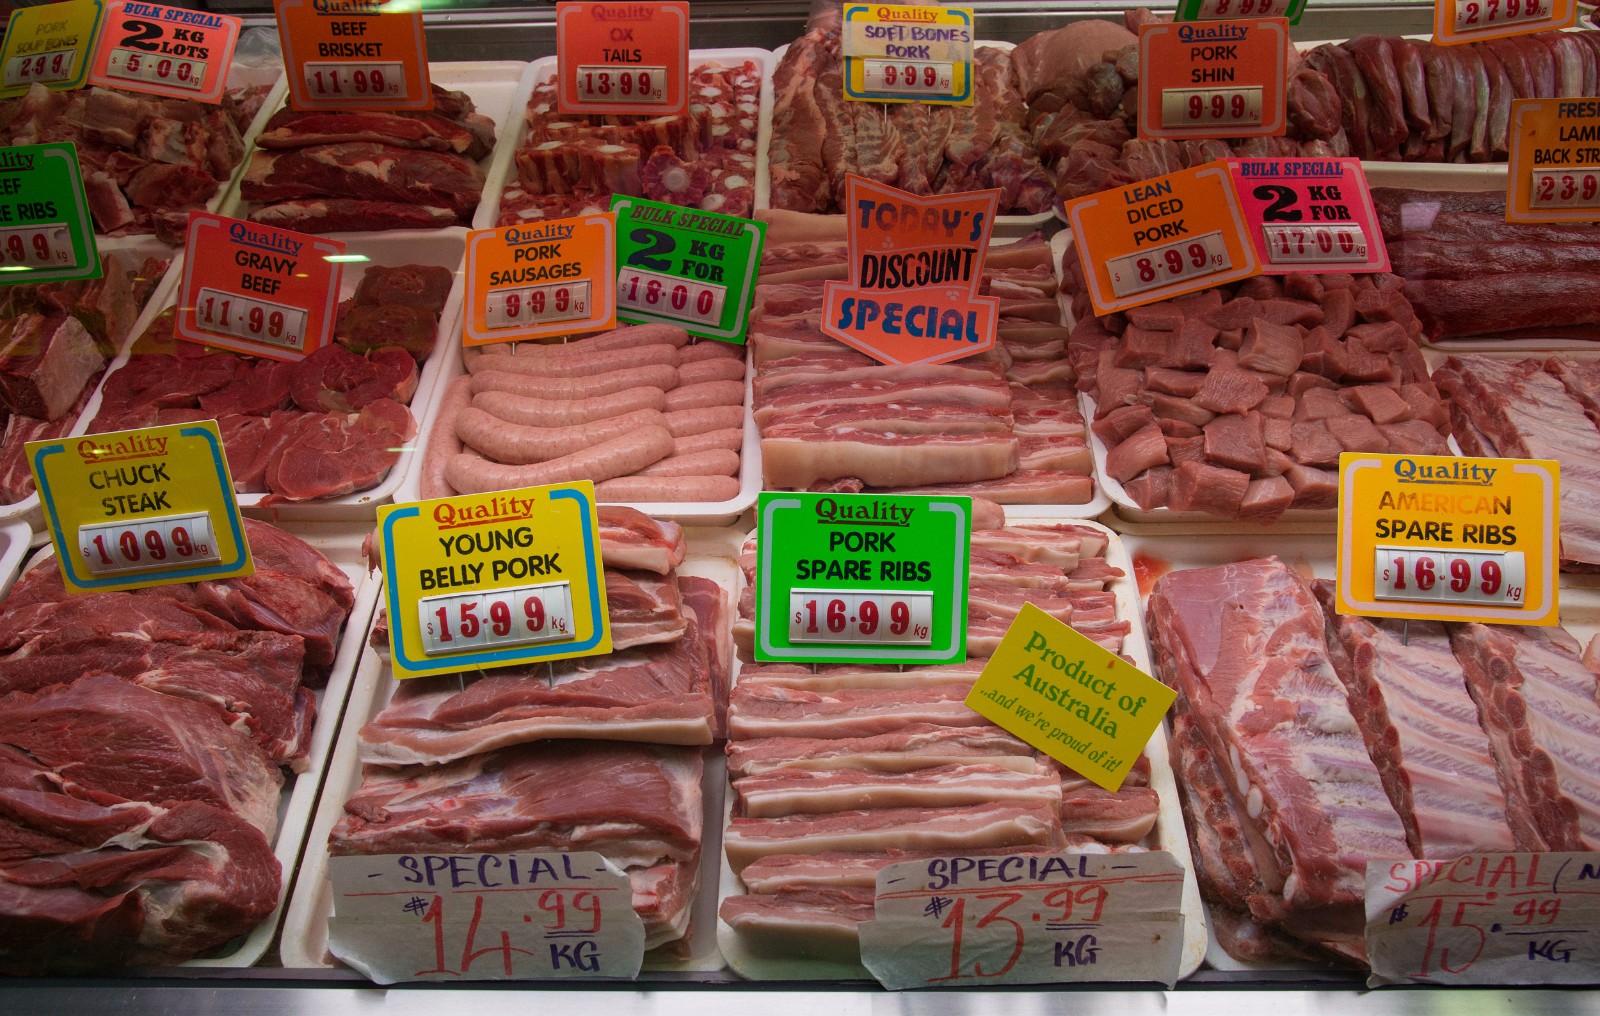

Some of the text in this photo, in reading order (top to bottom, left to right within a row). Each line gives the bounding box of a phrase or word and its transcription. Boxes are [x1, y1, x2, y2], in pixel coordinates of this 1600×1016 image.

[123, 2, 222, 28] BULK SPECIAL
[592, 5, 654, 20] Quality
[877, 7, 938, 22] Quality
[1537, 7, 1548, 16] kg
[120, 20, 163, 51] 2
[173, 28, 204, 43] KG
[331, 22, 367, 36] BEEF
[610, 28, 633, 42] OX
[865, 25, 969, 42] SOFT BONES
[1178, 24, 1249, 40] Quality
[160, 42, 209, 59] LOTS
[318, 43, 383, 57] BRISKET
[602, 49, 642, 63] TAILS
[886, 44, 930, 59] PORK
[1191, 45, 1238, 61] PORK
[190, 73, 199, 86] kg
[940, 78, 949, 88] kg
[1191, 67, 1235, 83] SHIN
[389, 83, 398, 93] kg
[653, 88, 661, 97] kg
[1534, 149, 1571, 164] BACK
[1241, 162, 1344, 176] BULK SPECIAL
[1124, 180, 1172, 205] LEAN
[1253, 184, 1303, 222] 2
[1307, 185, 1342, 201] KG
[17, 201, 58, 221] RIBS
[630, 205, 745, 237] BULK SPECIAL
[858, 199, 984, 241] TODAY'S
[1126, 198, 1184, 225] DICED
[1309, 205, 1351, 221] FOR
[230, 223, 303, 252] Quality
[505, 224, 575, 243] Quality
[1133, 219, 1188, 246] PORK
[56, 250, 68, 262] kg
[514, 244, 561, 263] PORK
[627, 228, 676, 271] 2
[689, 239, 725, 261] KG
[1210, 253, 1223, 266] kg
[1355, 245, 1366, 257] kg
[235, 250, 297, 276] GRAVY
[490, 262, 582, 286] SAUSAGES
[680, 259, 724, 282] FOR
[860, 248, 978, 289] DISCOUNT
[241, 273, 282, 295] BEEF
[574, 300, 585, 312] kg
[837, 297, 979, 343] SPECIAL
[286, 331, 297, 345] kg
[77, 434, 168, 460] Quality
[89, 462, 171, 490] CHUCK
[1394, 459, 1497, 484] Quality
[101, 490, 172, 516] STEAK
[433, 496, 535, 525] Quality
[815, 497, 915, 524] Quality
[1378, 490, 1512, 516] AMERICAN
[438, 526, 533, 557] YOUNG
[829, 531, 896, 553] PORK
[1375, 518, 1517, 546] SPARE RIBS
[194, 542, 208, 555] kg
[420, 552, 562, 591] BELLY PORK
[796, 559, 932, 582] SPARE RIBS
[1506, 583, 1522, 601] kg
[551, 616, 566, 632] kg
[914, 624, 928, 640] kg
[1023, 630, 1147, 717] Product of
[1013, 663, 1119, 739] Australia
[1015, 703, 1050, 732] we're
[1047, 727, 1092, 755] proud
[1088, 748, 1108, 766] of
[1103, 756, 1123, 773] it!
[550, 940, 602, 972] KG
[1054, 934, 1103, 967] KG
[1528, 940, 1577, 963] KG
